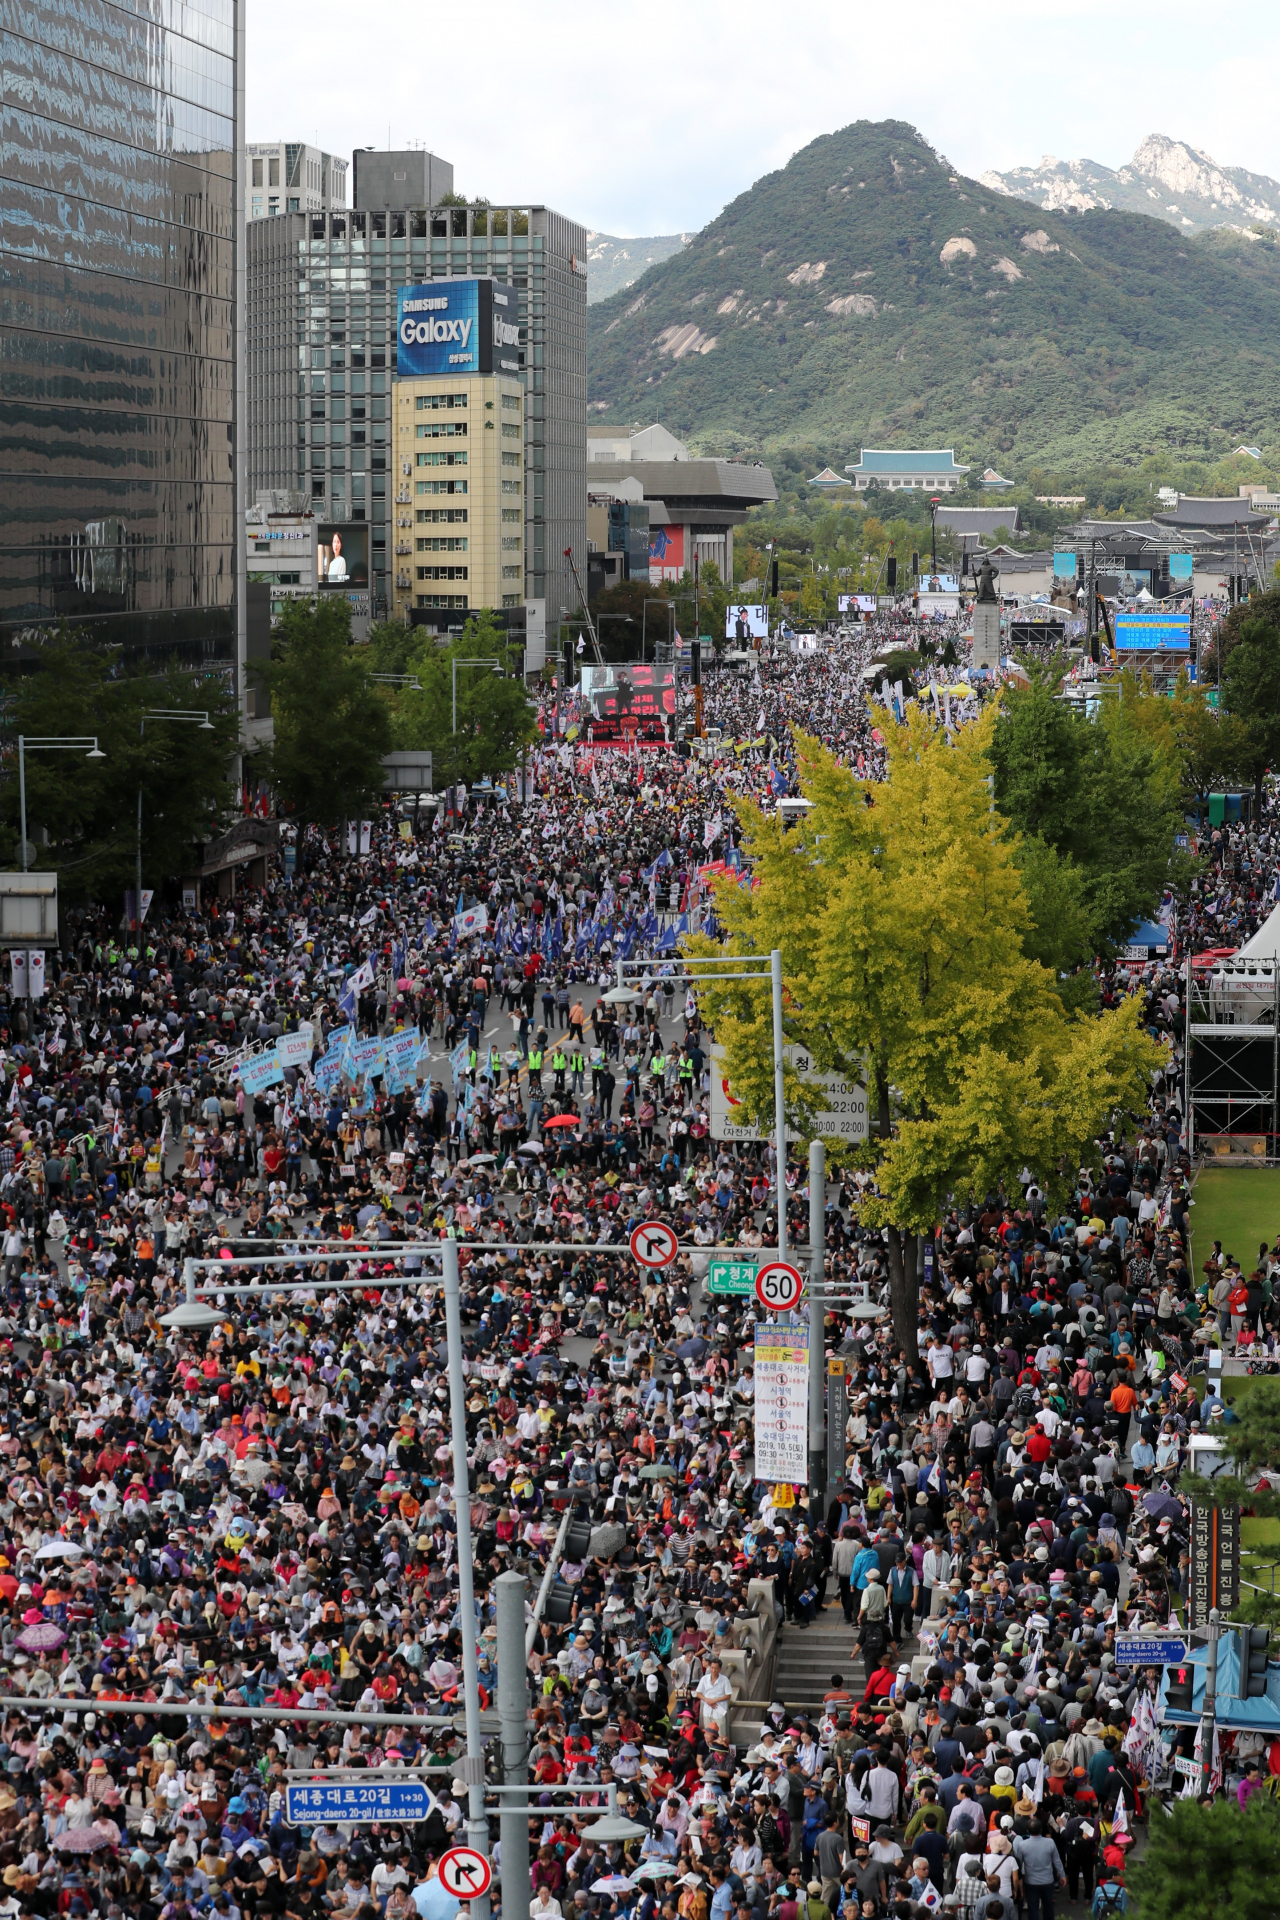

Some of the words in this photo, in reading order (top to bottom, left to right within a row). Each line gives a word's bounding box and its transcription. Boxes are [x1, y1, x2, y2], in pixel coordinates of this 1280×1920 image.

[402, 296, 448, 313] SAMSUNG
[400, 316, 472, 348] Galaxy
[449, 352, 473, 364] 삼성갤럭시
[723, 1127, 752, 1137] (자전거
[729, 1266, 759, 1281] 청계
[728, 1279, 756, 1291] Cheongg
[765, 1275, 793, 1299] 50
[757, 1325, 770, 1333] 2019
[757, 1334, 807, 1348] 교통통제안내
[756, 1362, 784, 1373] 세종대로
[787, 1364, 807, 1375] 사거리
[770, 1386, 792, 1397] 시청역
[834, 1386, 842, 1411] 지하철
[770, 1409, 792, 1420] 서울역
[834, 1413, 842, 1429] 타는
[762, 1431, 798, 1443] 숙대입구역
[834, 1431, 842, 1440] 곳
[758, 1449, 777, 1458] 09:30
[785, 1452, 804, 1461] 11:30
[1196, 1506, 1210, 1627] 한국방송광고진흥공
[1220, 1507, 1234, 1636] 한국언론진흥재
[1118, 1642, 1163, 1651] 세종대로20길
[1152, 1650, 1167, 1658] 20-gil
[293, 1788, 391, 1806] 세종대로20길
[293, 1808, 348, 1821] Sejong-daero
